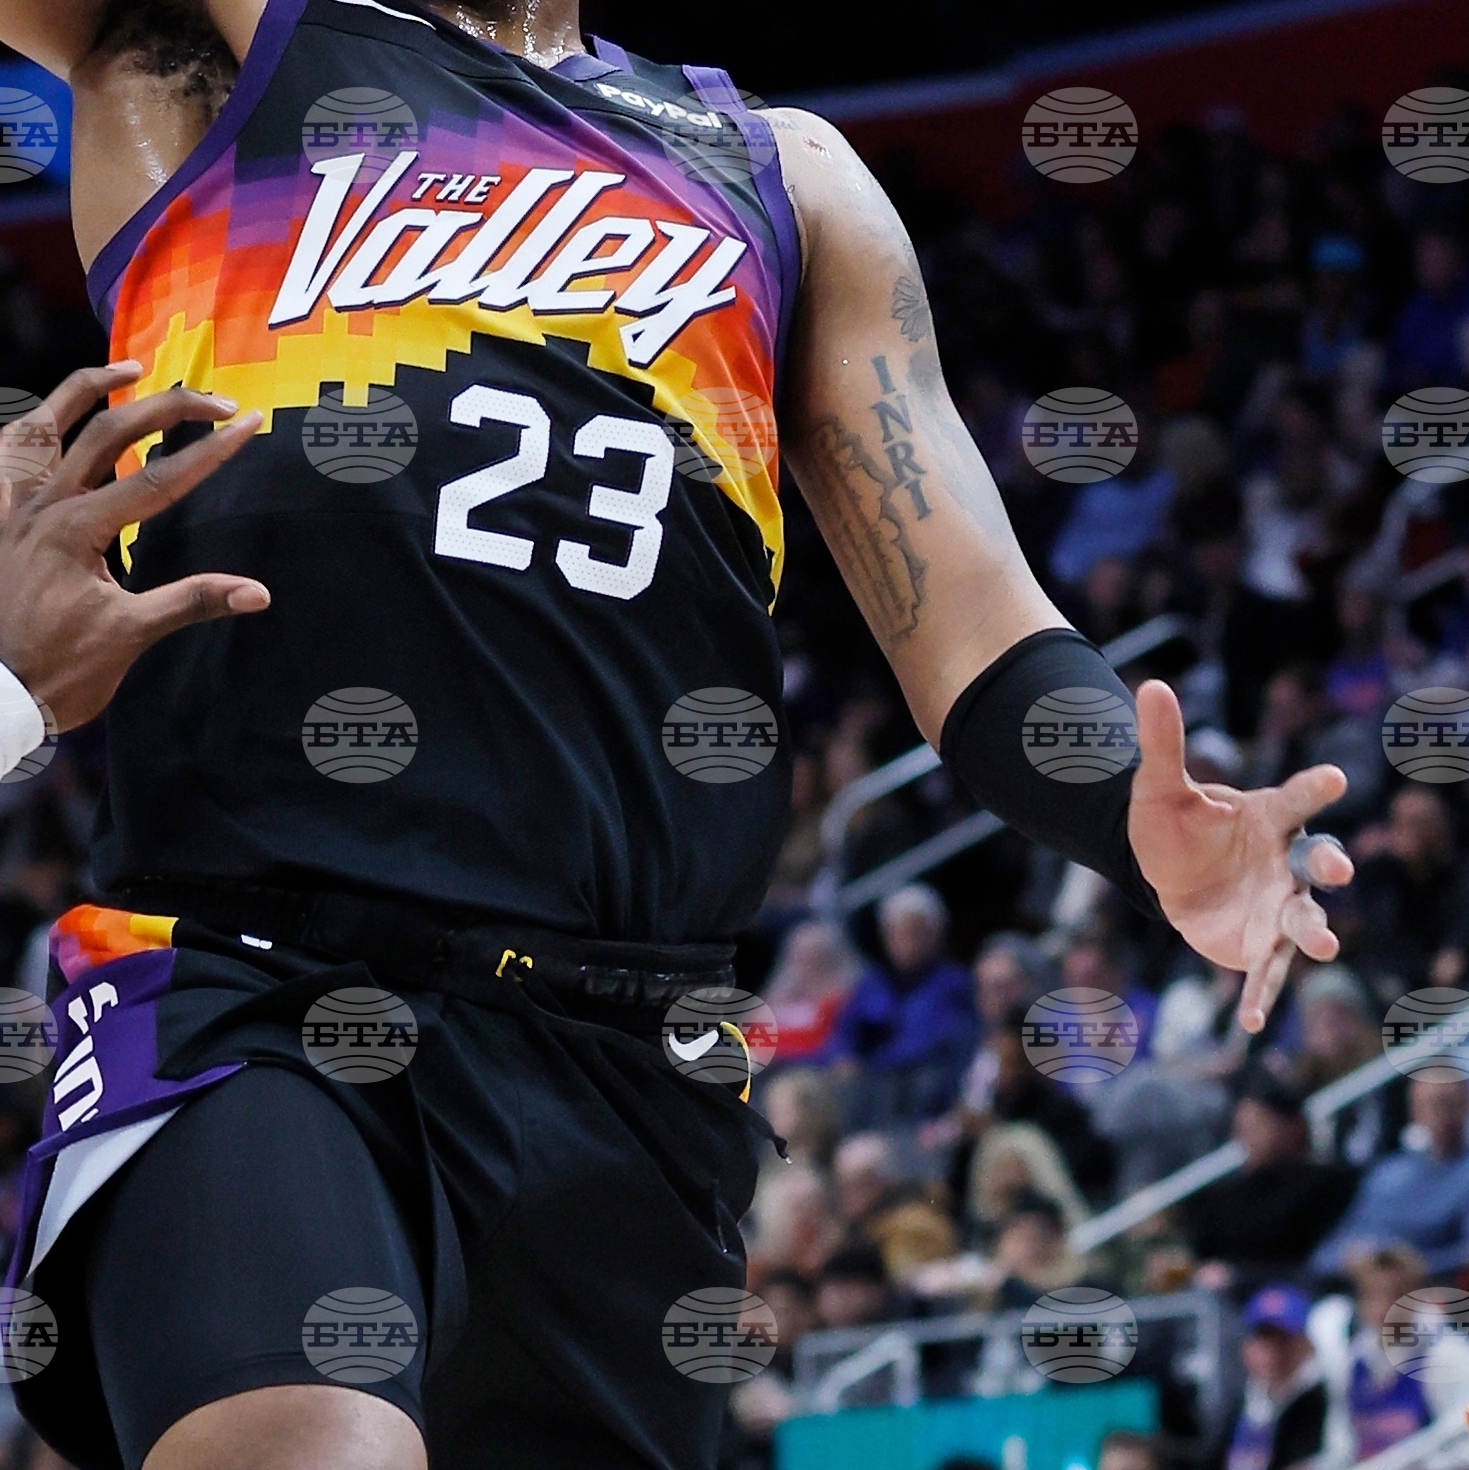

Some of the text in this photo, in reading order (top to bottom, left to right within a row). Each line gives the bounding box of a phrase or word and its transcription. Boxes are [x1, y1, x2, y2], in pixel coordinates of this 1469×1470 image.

[595, 82, 723, 129] PayPal
[412, 171, 500, 205] THE
[268, 149, 748, 369] Valley
[434, 382, 676, 602] 23
